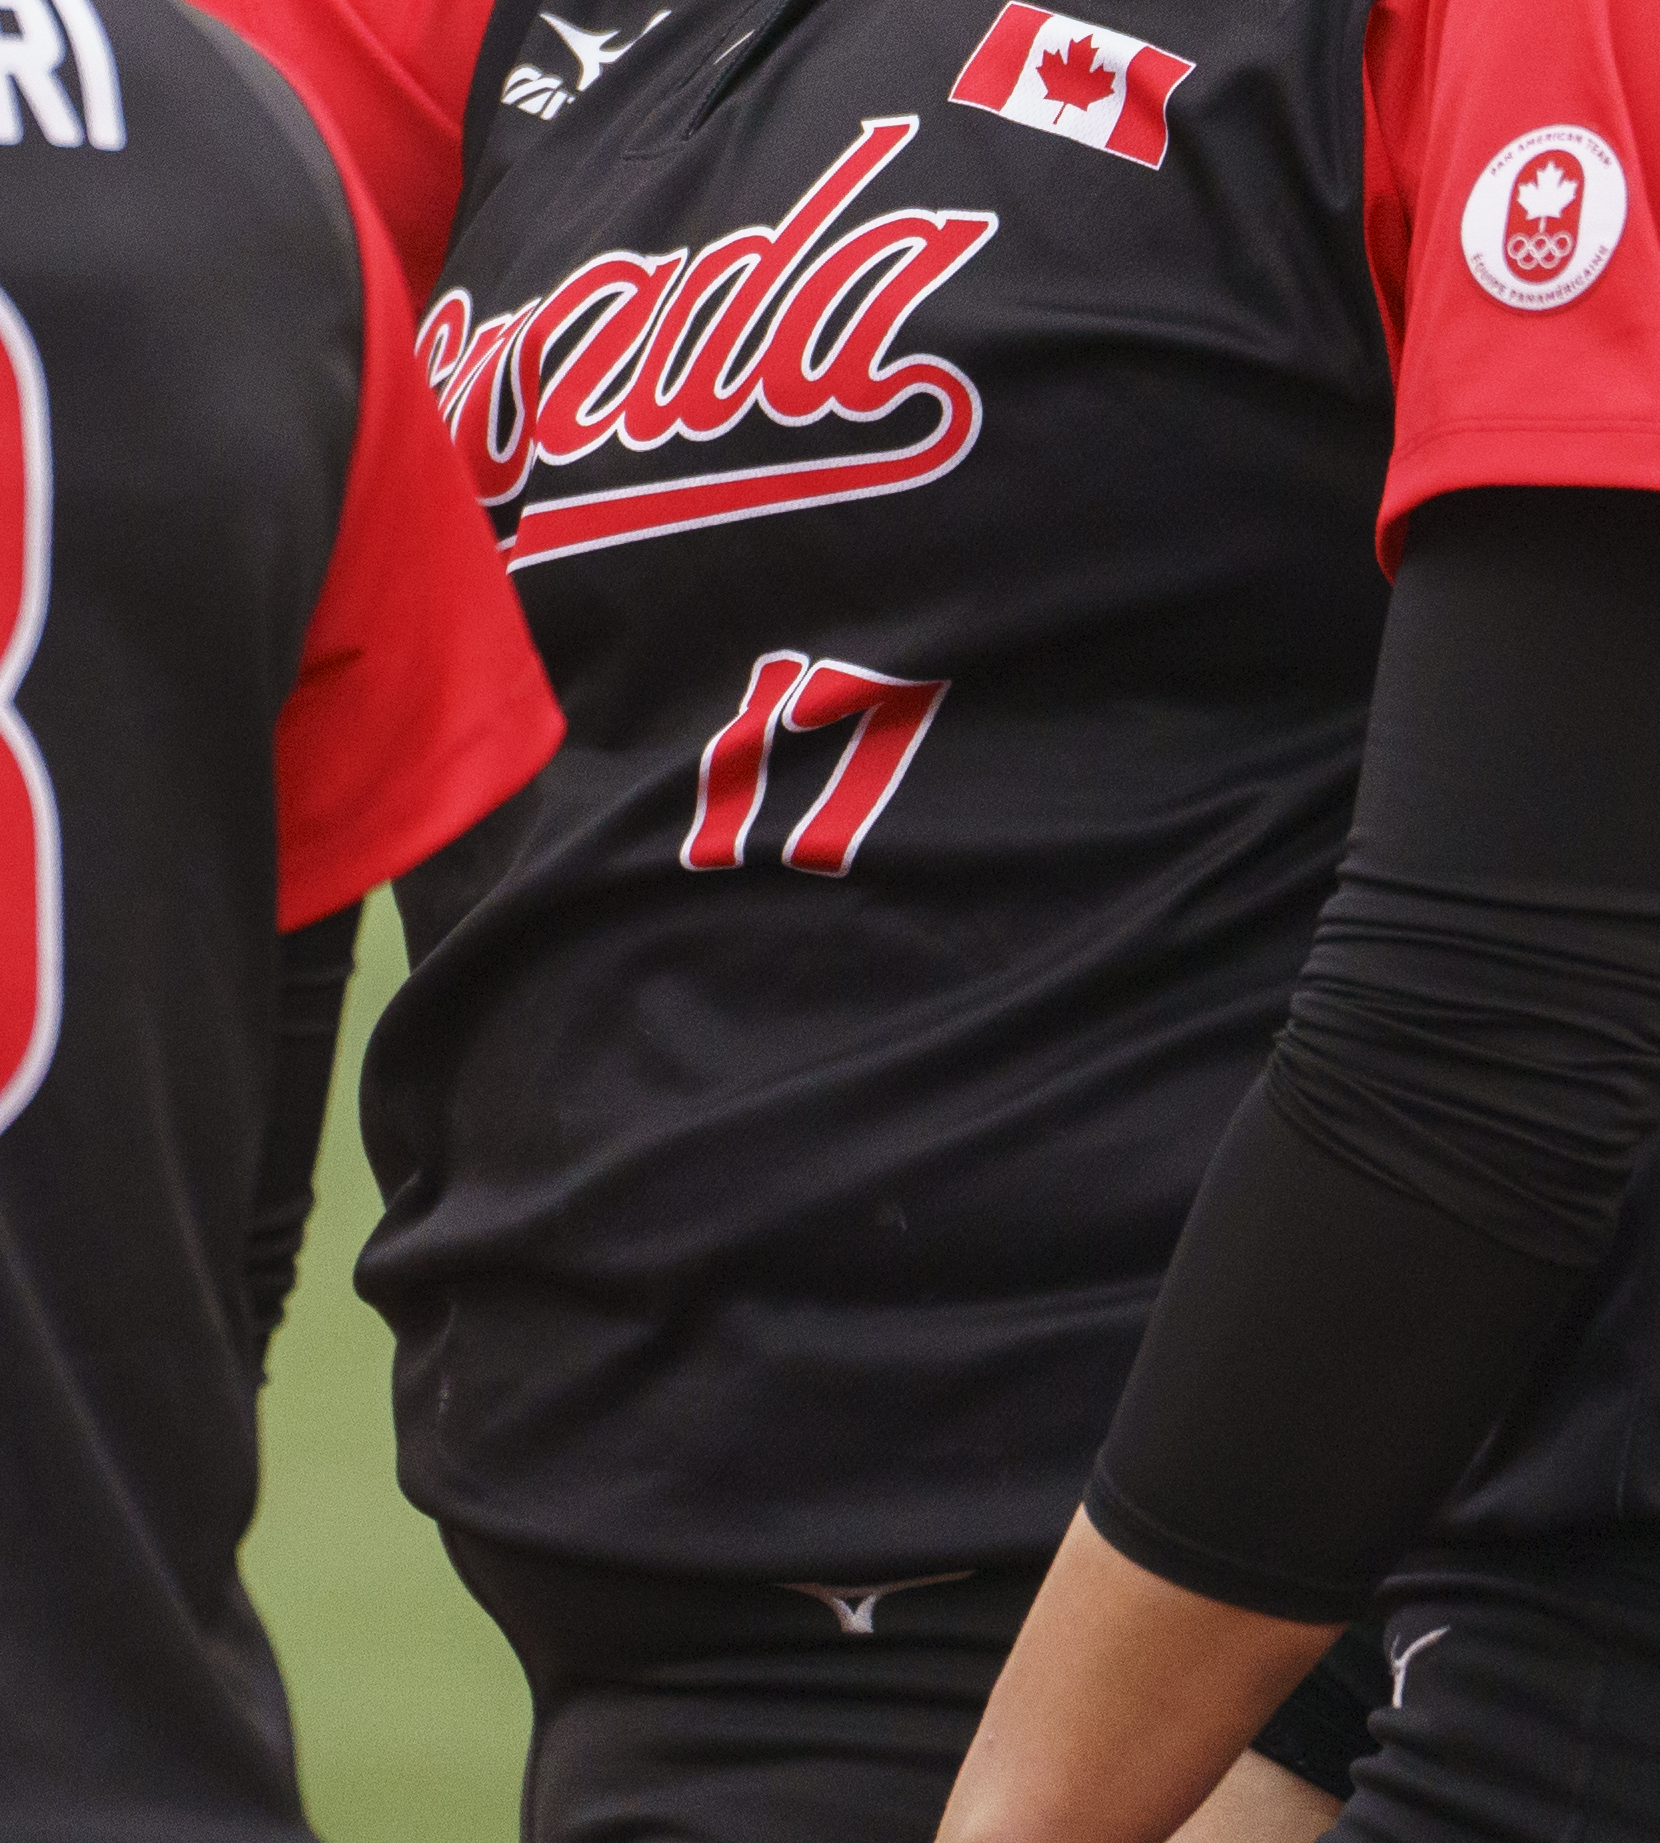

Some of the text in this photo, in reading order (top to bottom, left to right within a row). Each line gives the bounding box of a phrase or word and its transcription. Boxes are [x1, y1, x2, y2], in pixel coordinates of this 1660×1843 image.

[1490, 152, 1513, 177] PAN
[414, 114, 1000, 574] nada
[679, 649, 952, 879] 17
